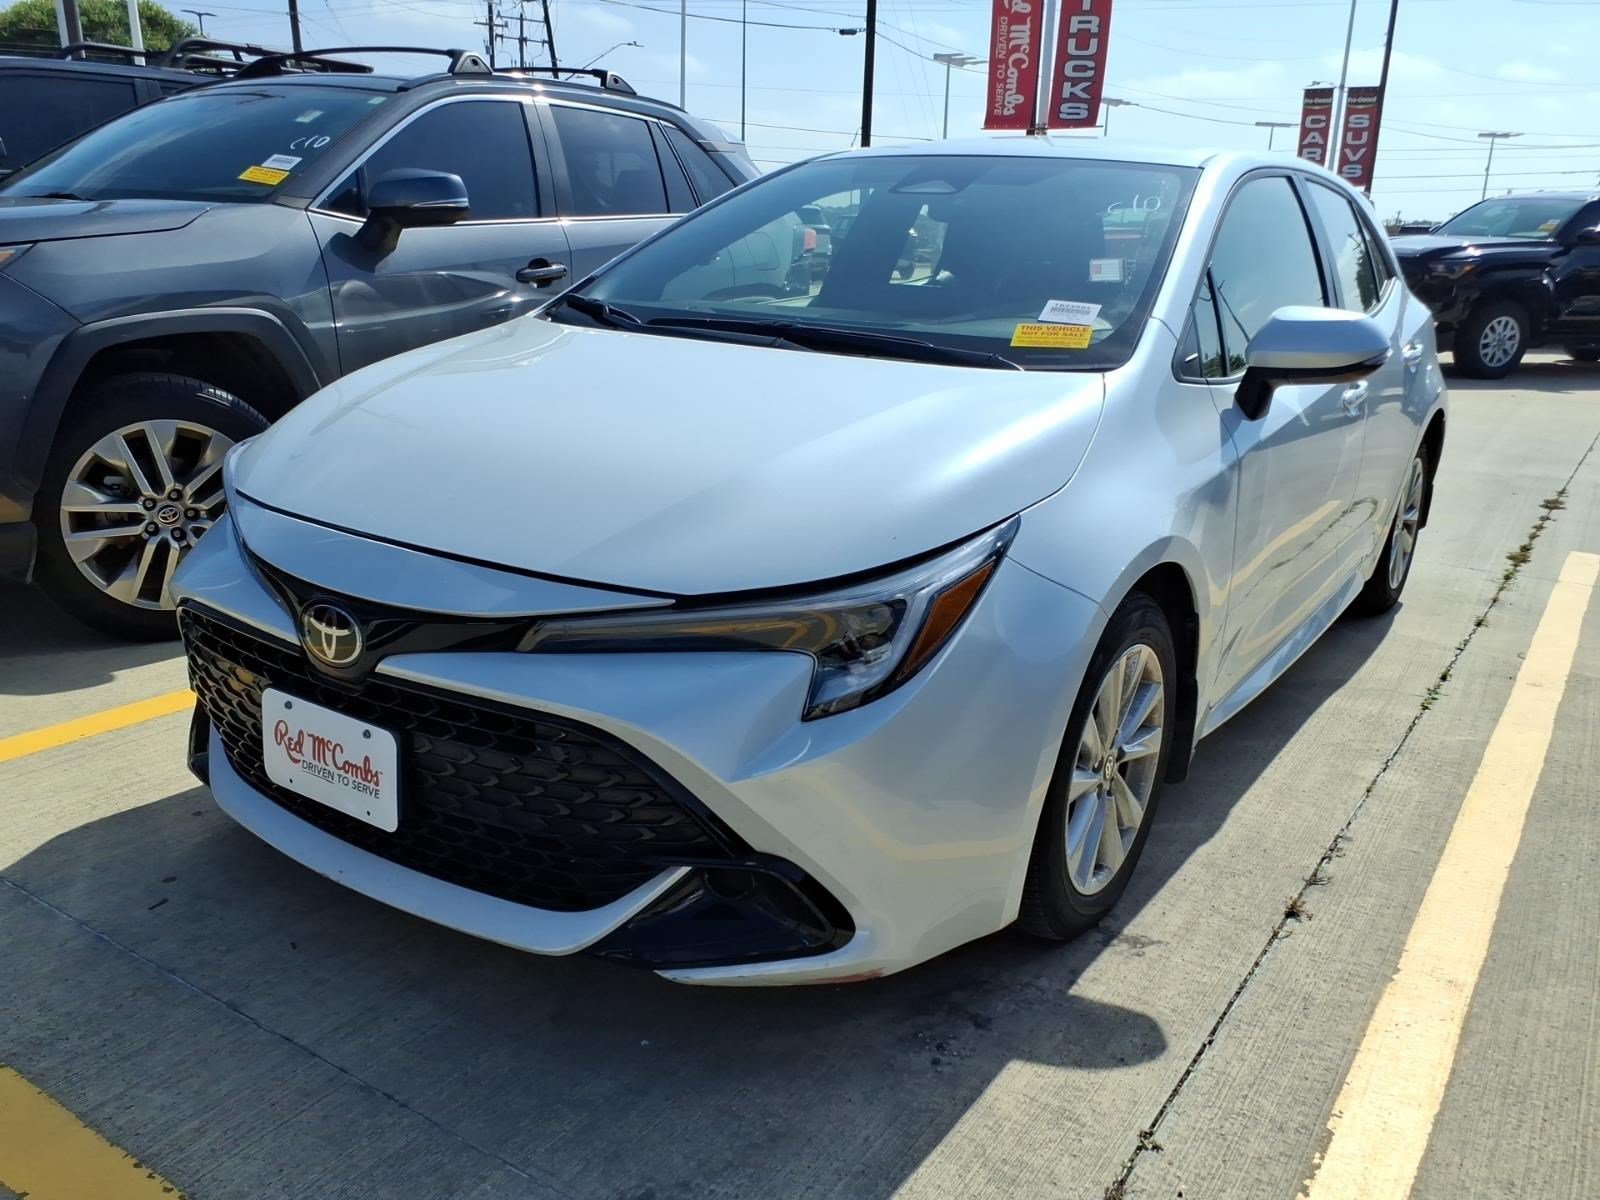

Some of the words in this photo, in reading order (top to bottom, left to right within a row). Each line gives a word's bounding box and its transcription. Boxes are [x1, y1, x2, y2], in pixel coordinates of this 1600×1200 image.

[997, 16, 1009, 59] DRIVEN
[996, 63, 1006, 79] TO
[1003, 16, 1032, 116] McCombs
[994, 82, 1004, 116] SERVE
[1341, 114, 1370, 177] SUVS
[1046, 325, 1090, 333] VEHICLE
[274, 719, 305, 764] Red
[307, 731, 380, 787] McCombs
[302, 760, 335, 782] DRIVEN
[337, 773, 350, 787] TO
[352, 780, 381, 799] SERVE
